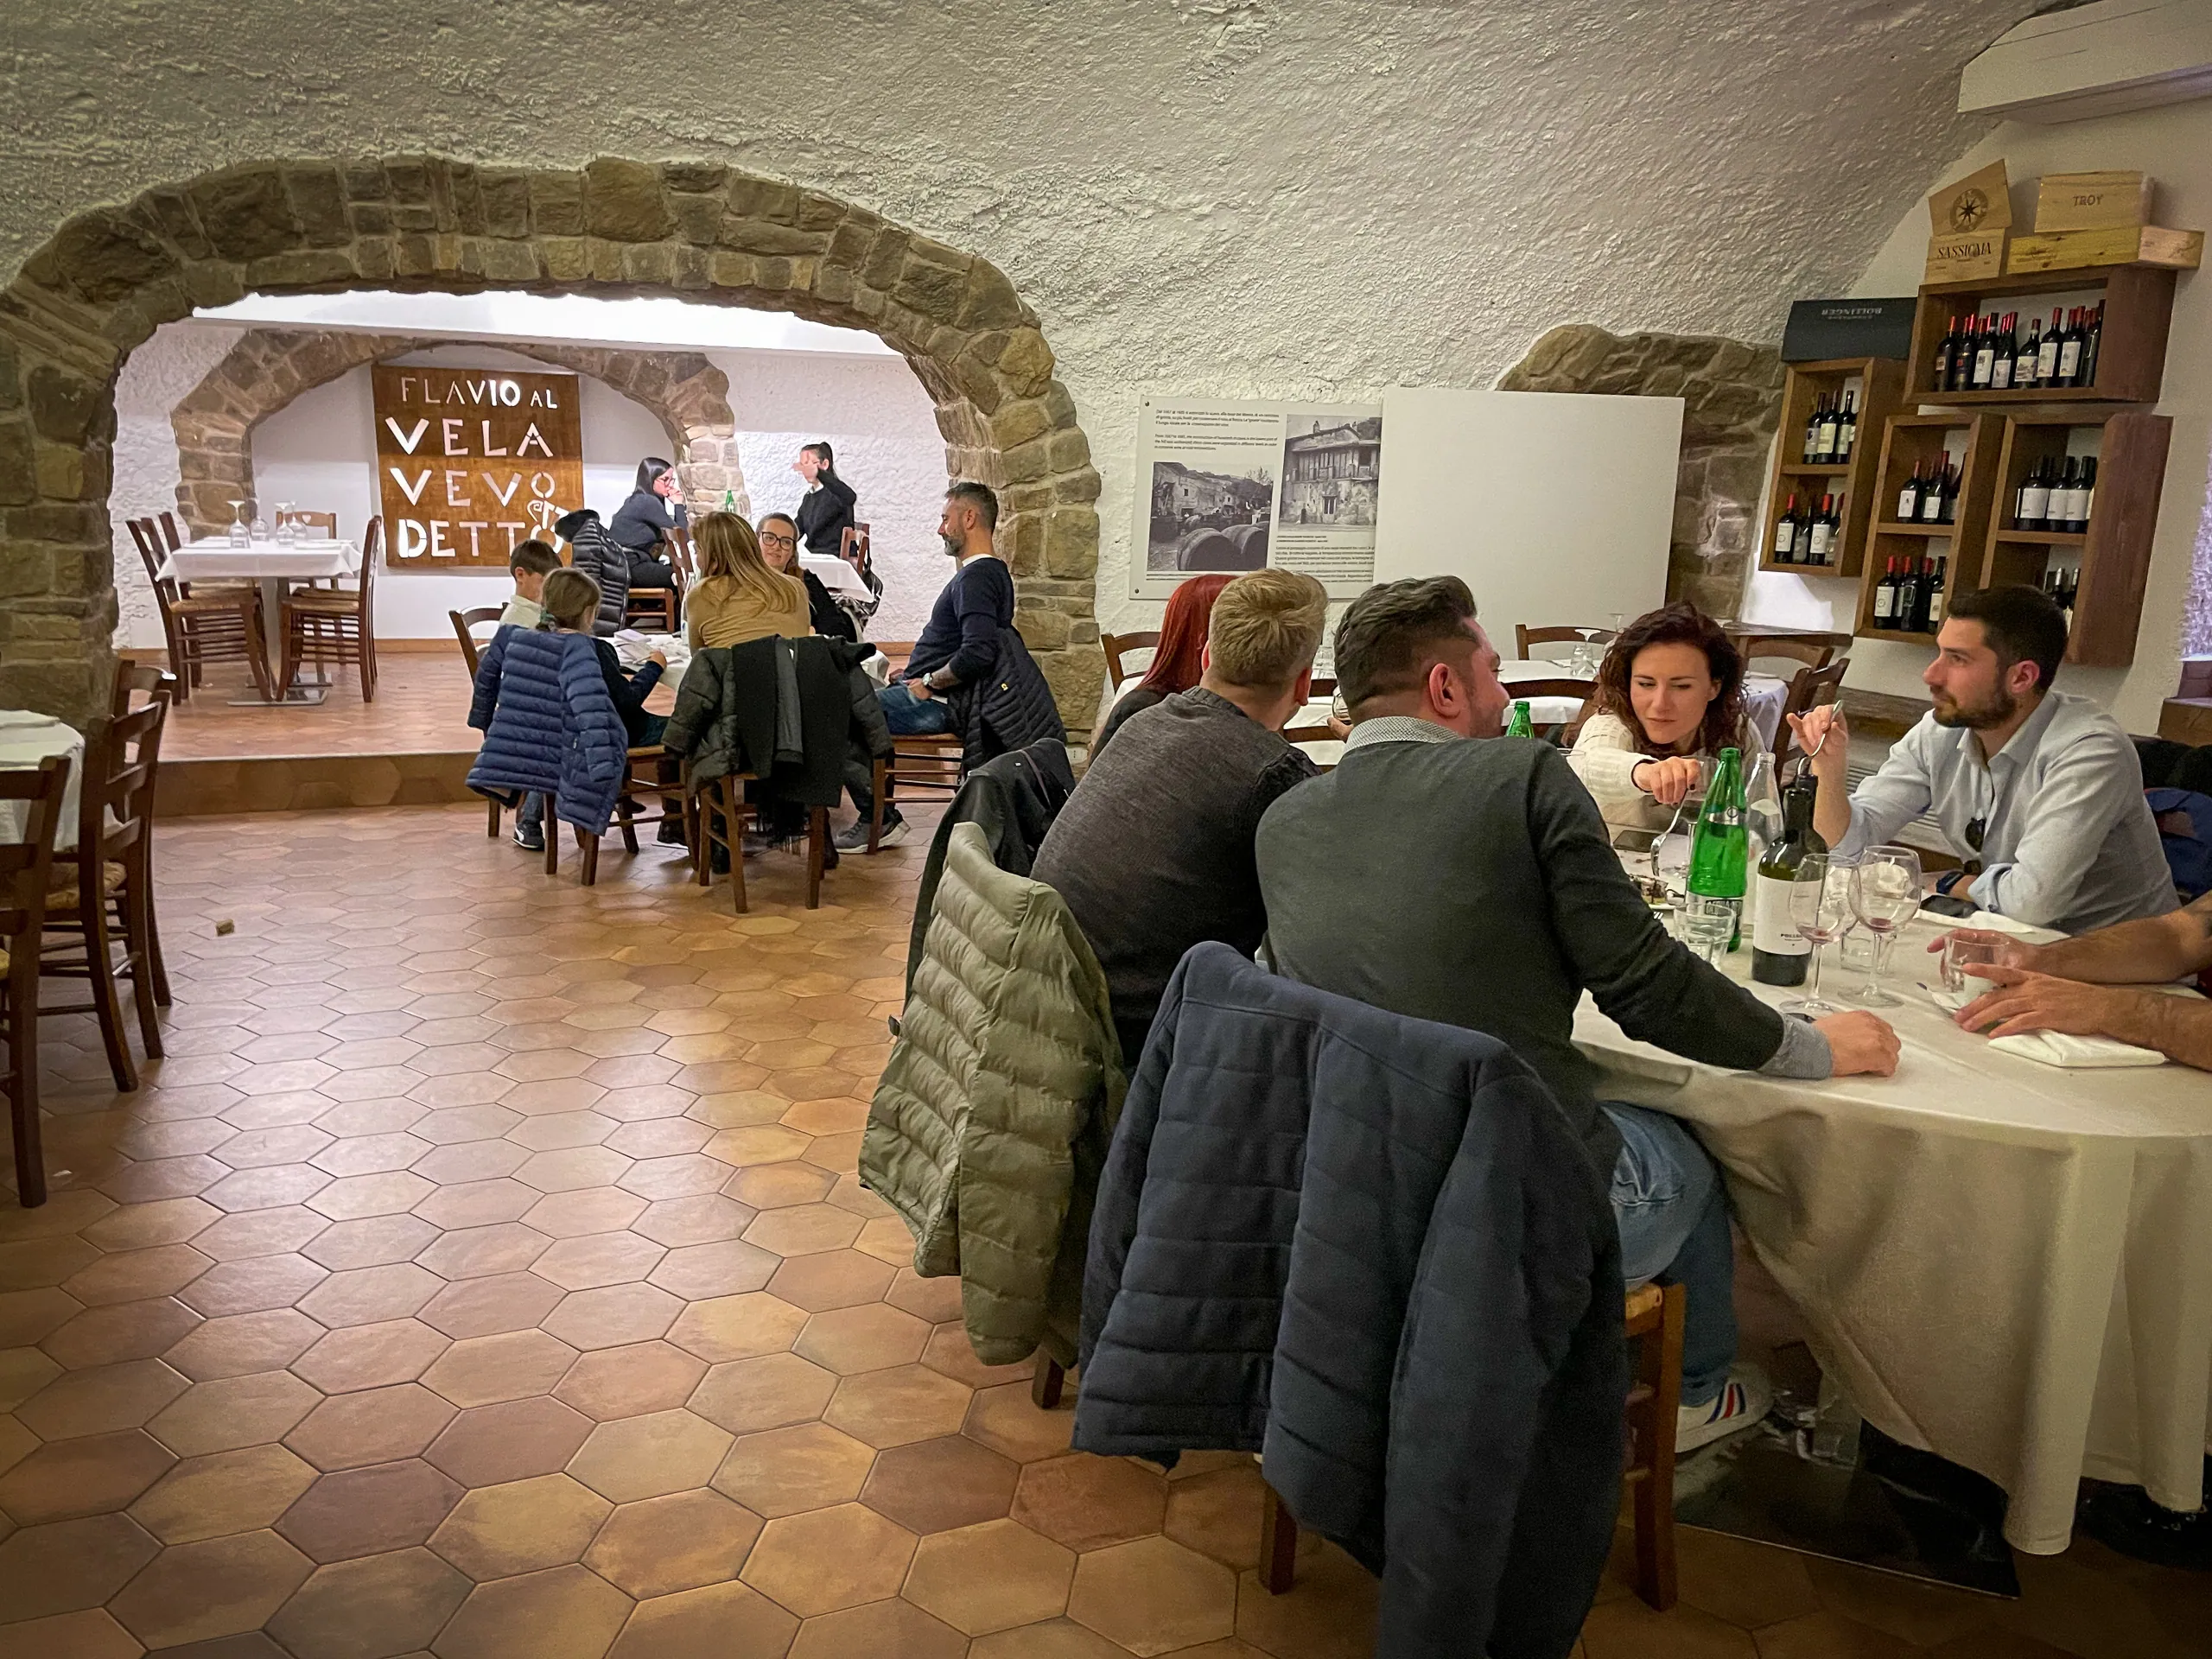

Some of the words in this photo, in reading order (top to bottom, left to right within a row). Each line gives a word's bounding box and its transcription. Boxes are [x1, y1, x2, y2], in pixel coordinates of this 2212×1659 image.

[2073, 194, 2104, 207] TROY
[401, 377, 521, 407] FLAVIO
[531, 389, 558, 409] AL
[385, 416, 554, 458] VELA
[389, 467, 556, 507] VEVO
